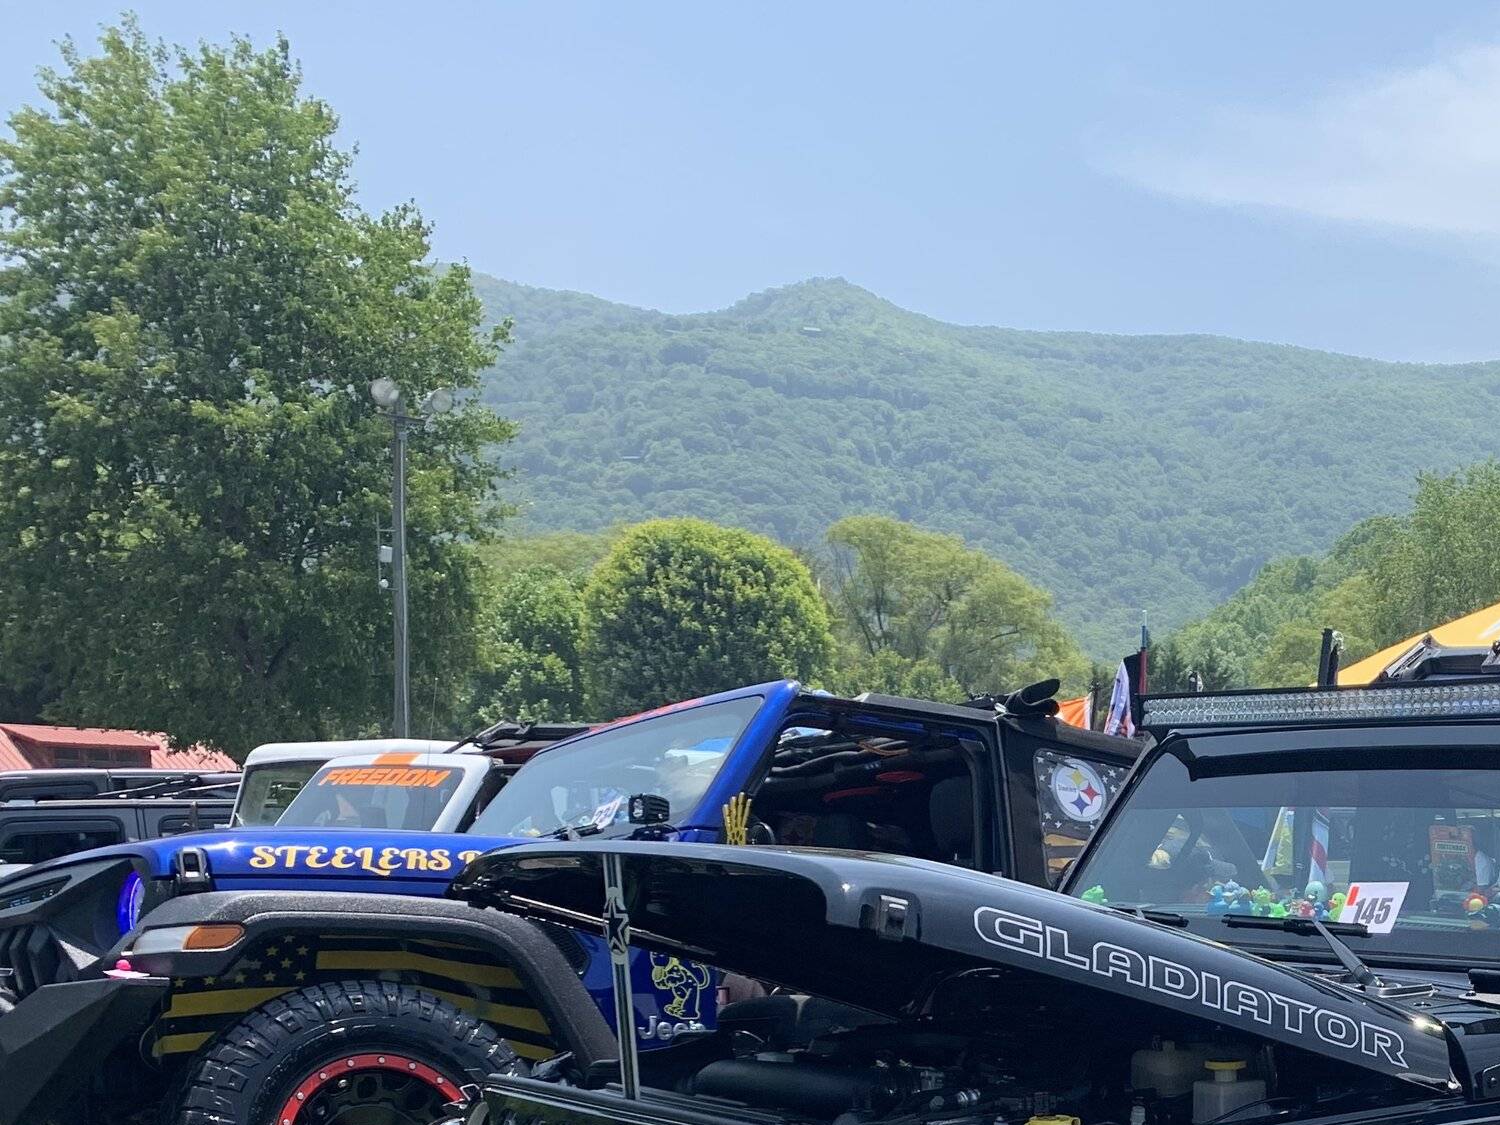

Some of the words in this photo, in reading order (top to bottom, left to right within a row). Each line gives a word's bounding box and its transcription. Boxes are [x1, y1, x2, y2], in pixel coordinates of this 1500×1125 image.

[318, 768, 451, 788] FREEDOM
[249, 845, 452, 877] STEELERS
[1353, 896, 1394, 925] 145
[973, 905, 1409, 1069] GLADIATOR
